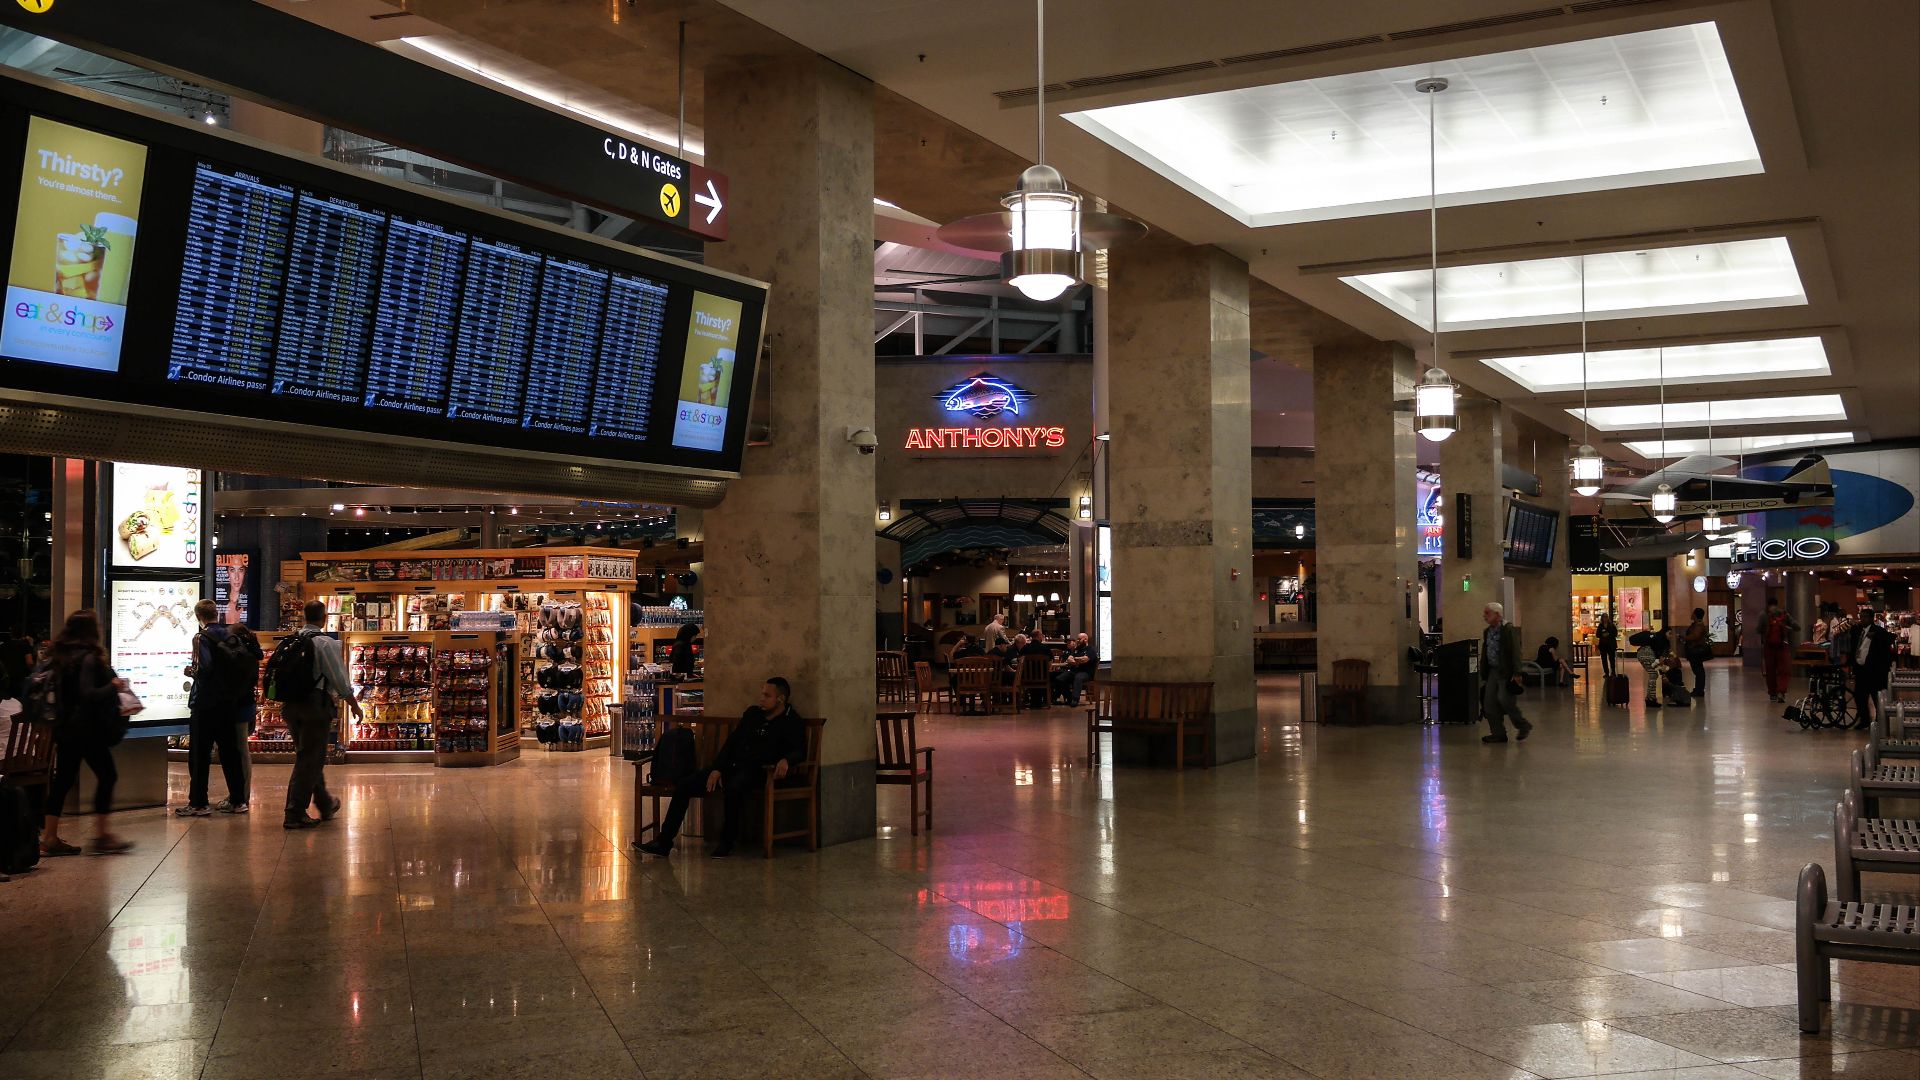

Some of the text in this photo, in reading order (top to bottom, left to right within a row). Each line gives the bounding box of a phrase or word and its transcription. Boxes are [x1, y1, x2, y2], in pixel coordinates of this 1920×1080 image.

[604, 138, 682, 180] C, D & N Gates
[37, 149, 124, 188] Thirsty?
[234, 171, 260, 184] ARRIVALS
[37, 176, 65, 190] You're
[66, 183, 94, 196] almost
[329, 196, 360, 210] DEPARTURES
[416, 220, 444, 232] DEPARTURES
[495, 241, 521, 252] DEPARTURES
[567, 259, 590, 270] DEPARTURES
[15, 302, 107, 333] eat & shop
[695, 311, 732, 332] Thirsty?
[217, 374, 245, 388] Airlines
[315, 389, 341, 400] Airlines
[403, 402, 426, 412] Airlines
[482, 413, 502, 423] Airlines
[553, 422, 571, 431] Airlines
[617, 430, 634, 439] Airlines
[905, 427, 1065, 449] ANTHONY'S
[520, 558, 545, 569] TIME
[1604, 562, 1630, 573] SHOP
